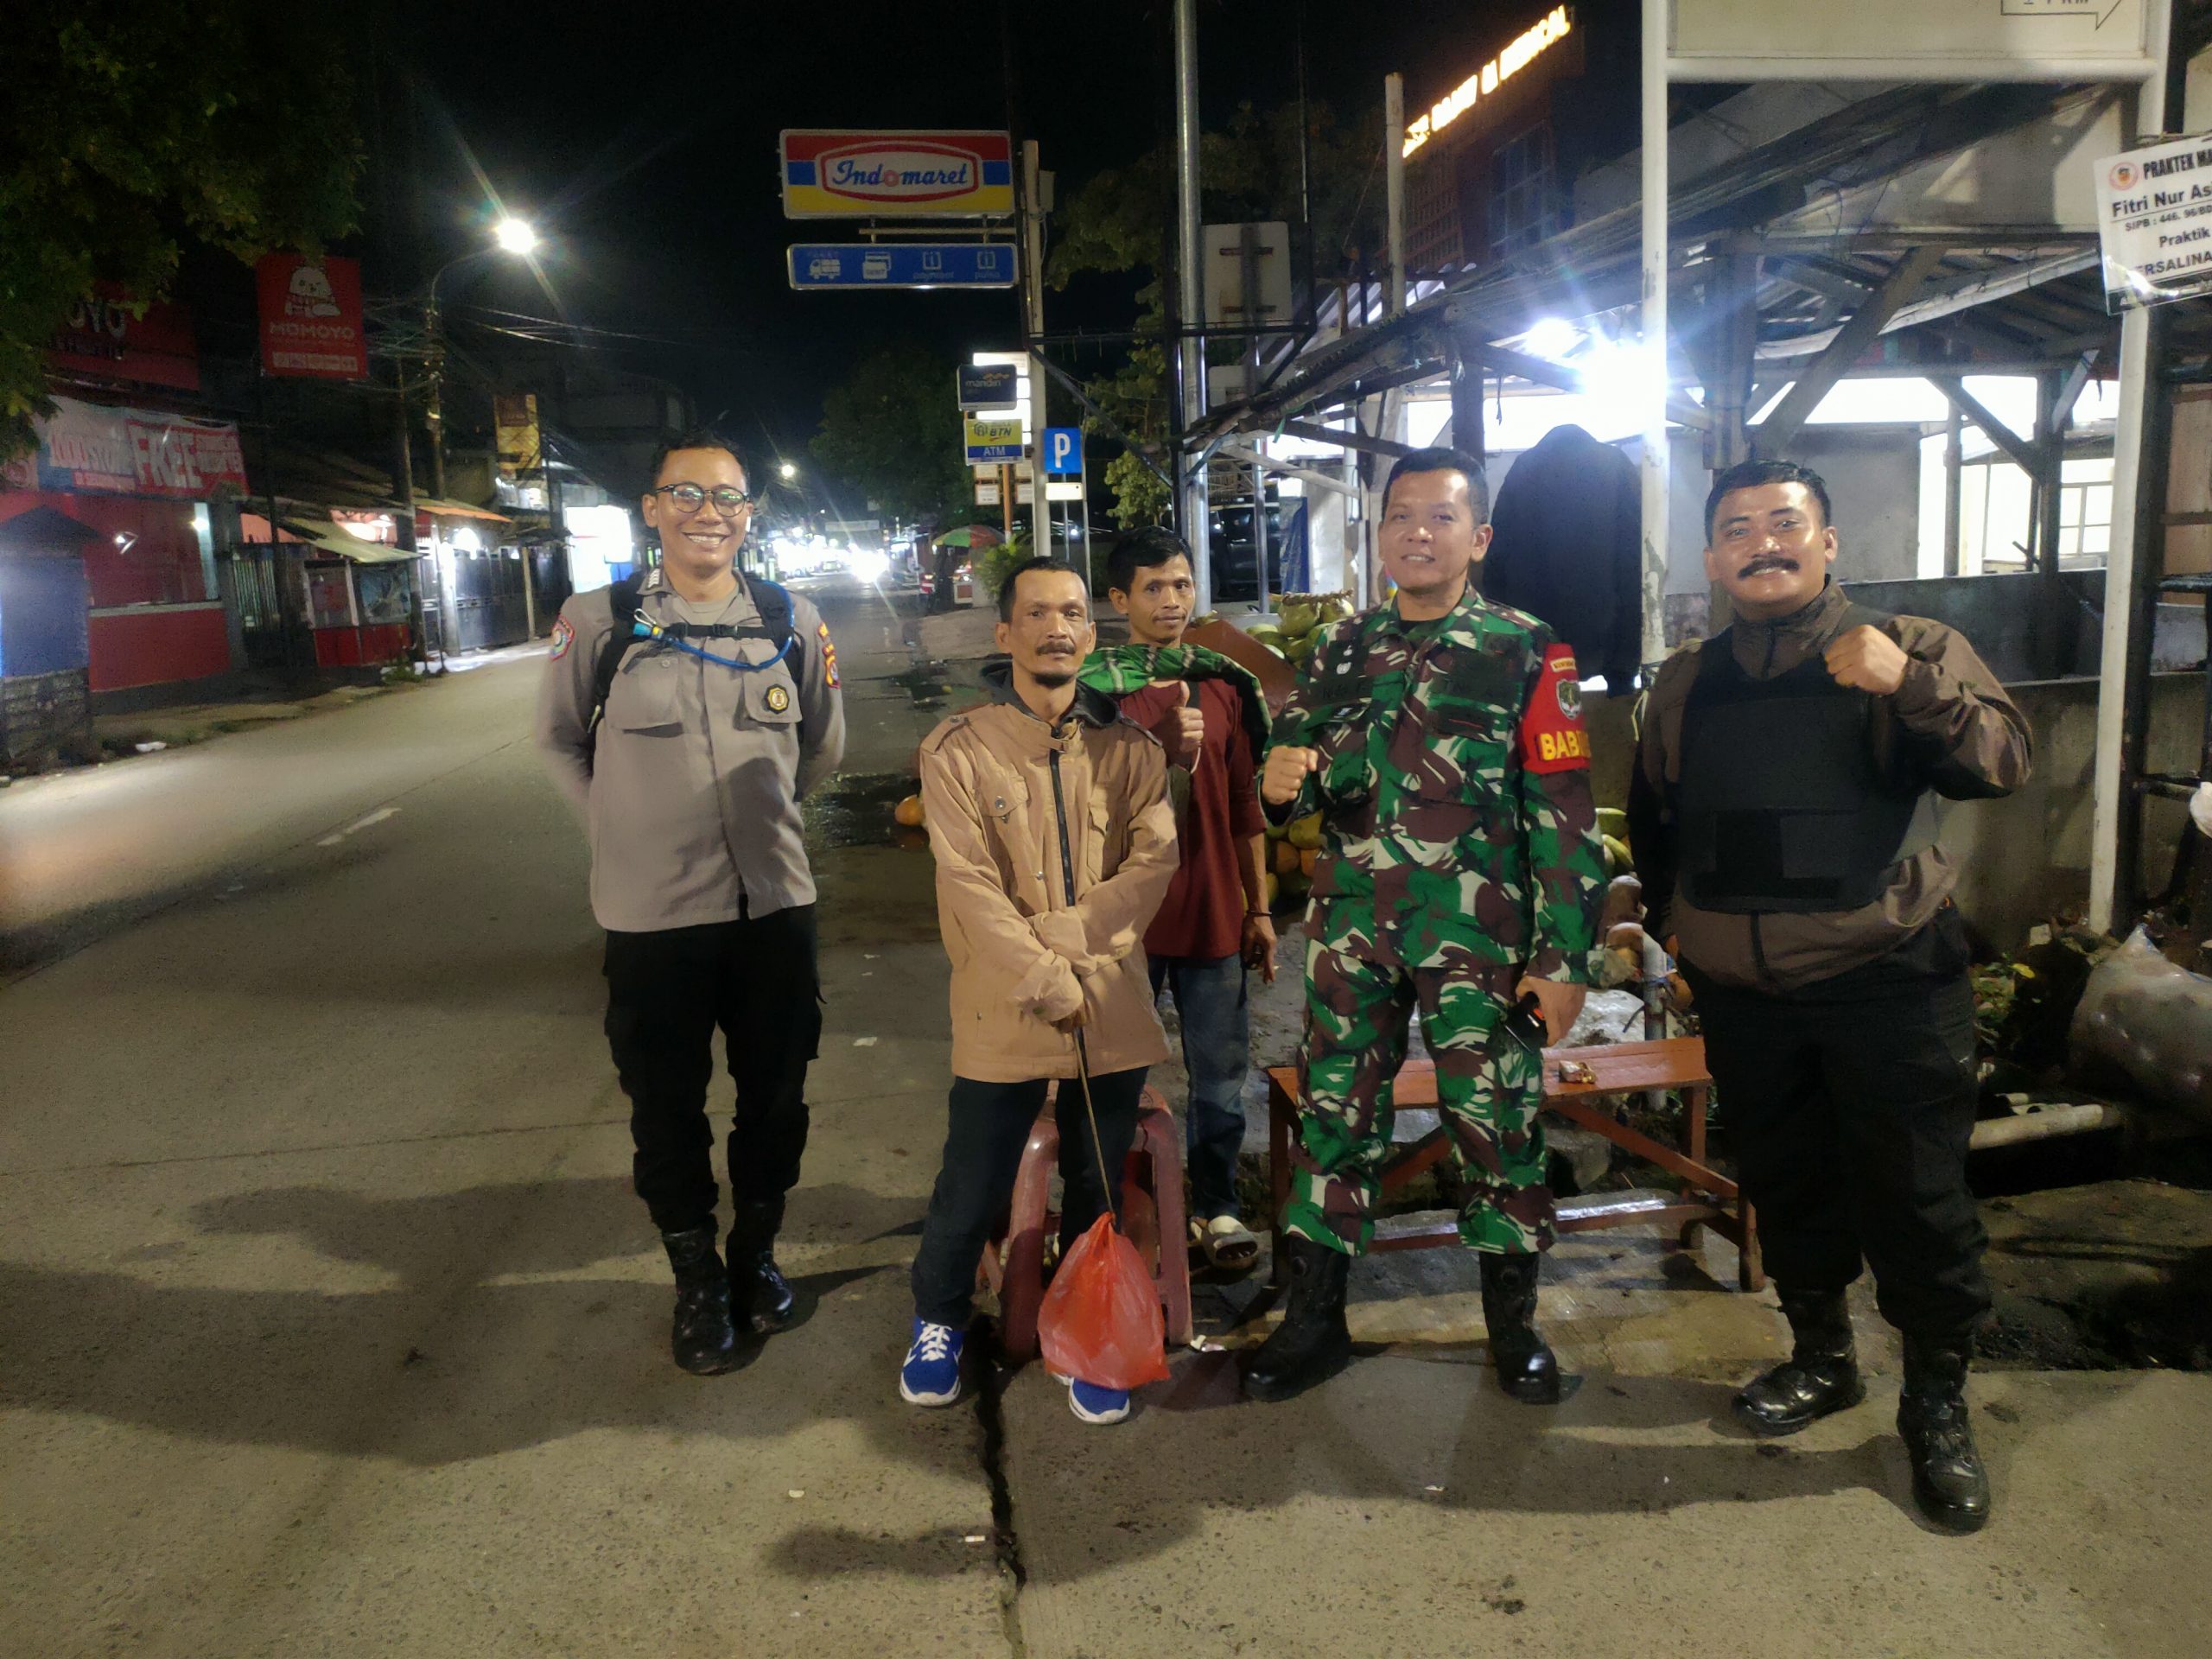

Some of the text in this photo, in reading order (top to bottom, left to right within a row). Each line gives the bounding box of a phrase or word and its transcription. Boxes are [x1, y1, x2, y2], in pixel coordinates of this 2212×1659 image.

[832, 159, 968, 185] Indomaret
[2143, 152, 2195, 180] PRAKTEK
[2112, 195, 2149, 218] Fitri
[2154, 189, 2185, 208] Nur
[2125, 218, 2151, 232] SIPB
[2158, 226, 2211, 249] Praktik
[989, 427, 1012, 437] BTN
[982, 445, 1007, 456] ATM
[1053, 433, 1071, 468] P
